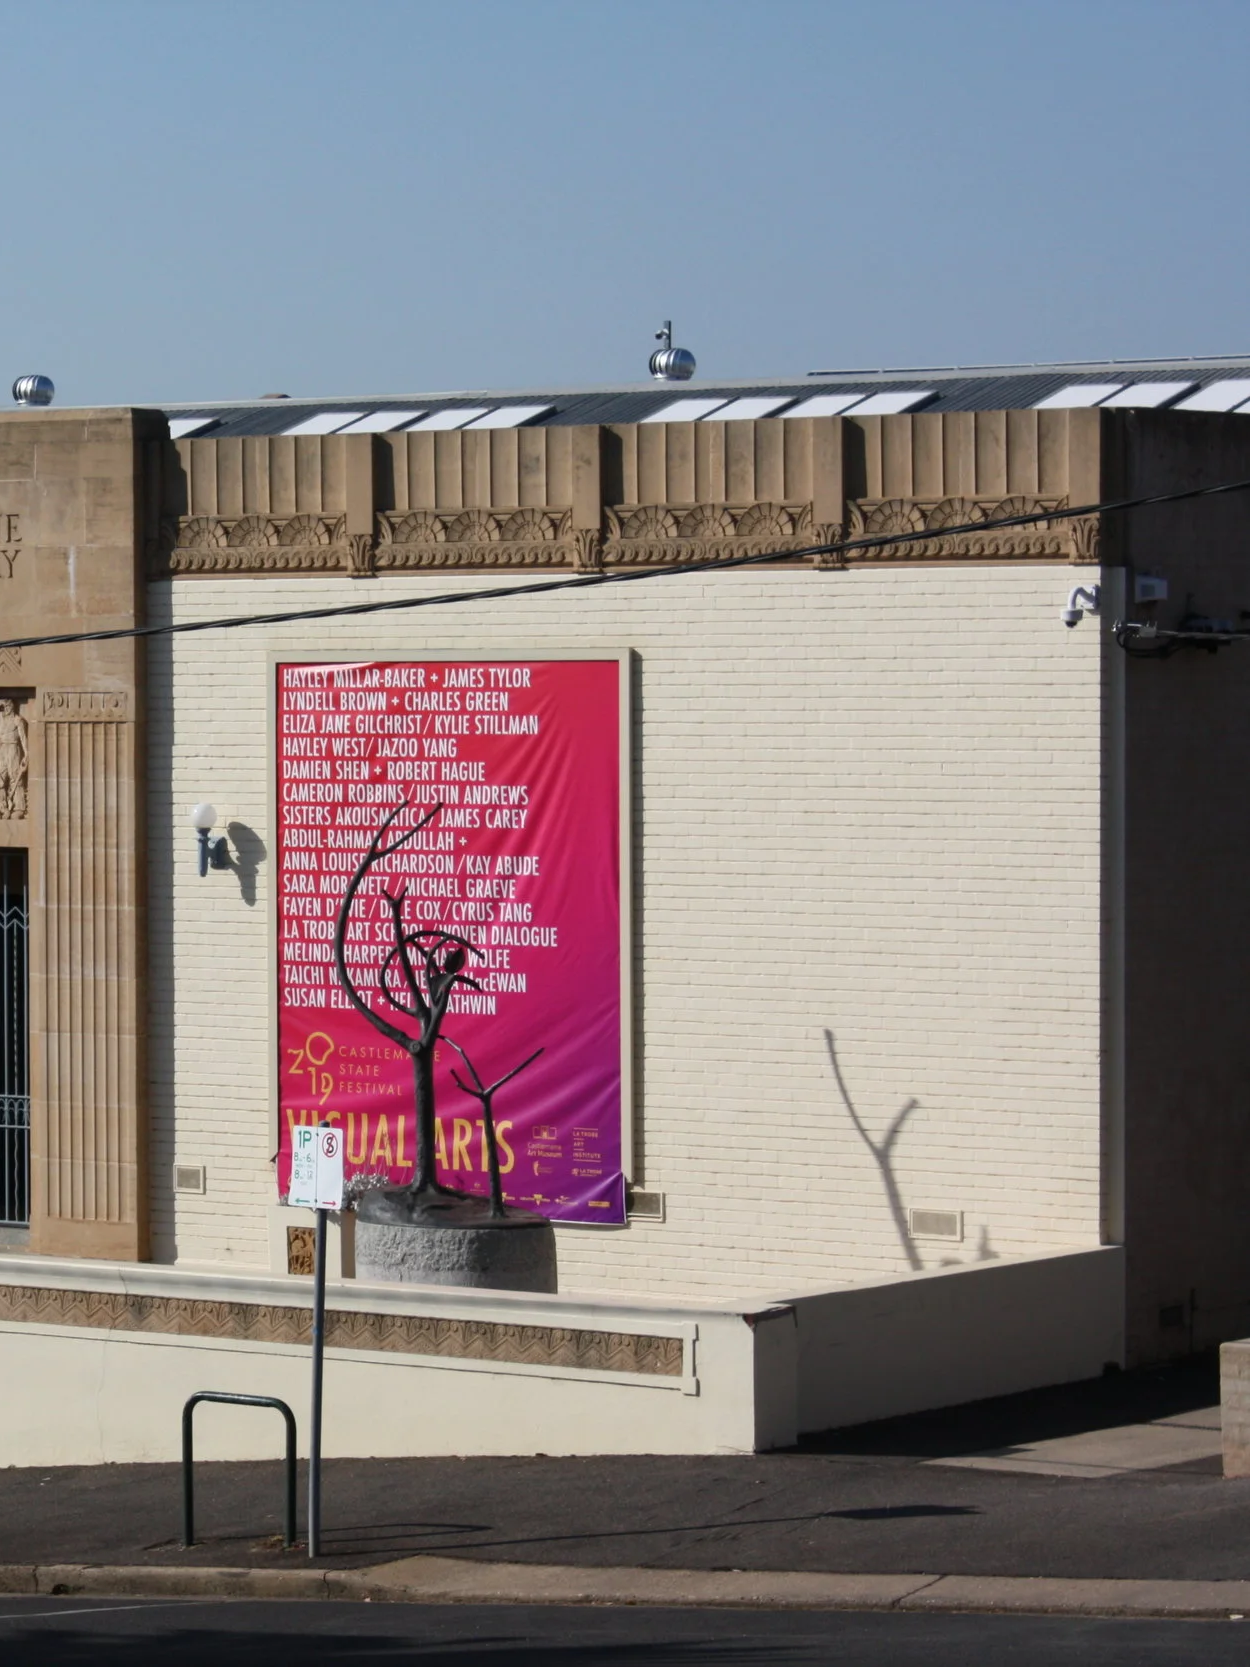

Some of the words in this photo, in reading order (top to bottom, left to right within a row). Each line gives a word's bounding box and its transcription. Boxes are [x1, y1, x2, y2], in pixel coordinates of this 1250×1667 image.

[283, 669, 328, 688] HAYLEY
[333, 668, 425, 688] MILLAR-BAKER
[430, 674, 438, 682] +
[442, 668, 484, 688] JAMES
[488, 668, 531, 688] TYLOR
[283, 692, 335, 711] LYNDELL
[340, 692, 386, 711] BROWN
[391, 697, 399, 706] +
[404, 692, 461, 712] CHARLES
[466, 692, 508, 712] GREEN
[283, 715, 316, 734] ELIZA
[320, 715, 350, 734] JANE
[355, 715, 422, 735] GILCHRIST
[434, 715, 470, 735] KYLIE
[475, 715, 538, 736] STILLMAN
[283, 737, 327, 757] HAYLEY
[332, 738, 366, 758] WEST
[376, 738, 418, 758] JAZOO
[423, 739, 458, 758] YANG
[283, 760, 330, 780] DAMIEN
[336, 761, 369, 780] SHEN
[374, 766, 382, 775] +
[387, 761, 437, 781] ROBERT
[441, 762, 486, 782] HAGUE
[283, 783, 342, 802] CAMERON
[349, 784, 405, 804] ROBBINS
[414, 784, 460, 805] JUSTIN
[464, 785, 528, 806] ANDREWS
[283, 806, 332, 826] SISTERS
[336, 807, 426, 828] AKOUSMATICA
[438, 808, 480, 828] JAMES
[485, 808, 528, 829] CAREY
[283, 829, 382, 849] ABDUL-RAHMAN
[386, 830, 454, 850] ABDULLAH
[283, 852, 318, 871] ANNA
[466, 855, 491, 875] KAY
[495, 856, 540, 876] ABUDE
[283, 874, 314, 894] SARA
[320, 875, 390, 896] MORWETZ
[405, 878, 462, 898] MICHAEL
[466, 878, 516, 899] GRAEVE
[284, 897, 322, 916] FAYEN
[416, 900, 441, 920] COX
[452, 901, 494, 922] CYRUS
[499, 903, 532, 923] TANG
[284, 919, 300, 938] LA
[347, 922, 370, 941] ART
[491, 926, 558, 947] DIALOGUE
[468, 948, 510, 969] WOLFE
[284, 965, 324, 985] TAICHI
[329, 966, 401, 988] NKAMURA
[284, 987, 326, 1008] SUSAN
[446, 994, 496, 1015] ATHWIN
[339, 1064, 380, 1077] STATE
[339, 1081, 402, 1096] FESTIVAL
[298, 1130, 312, 1148] 1P
[434, 1117, 515, 1174] ARTS
